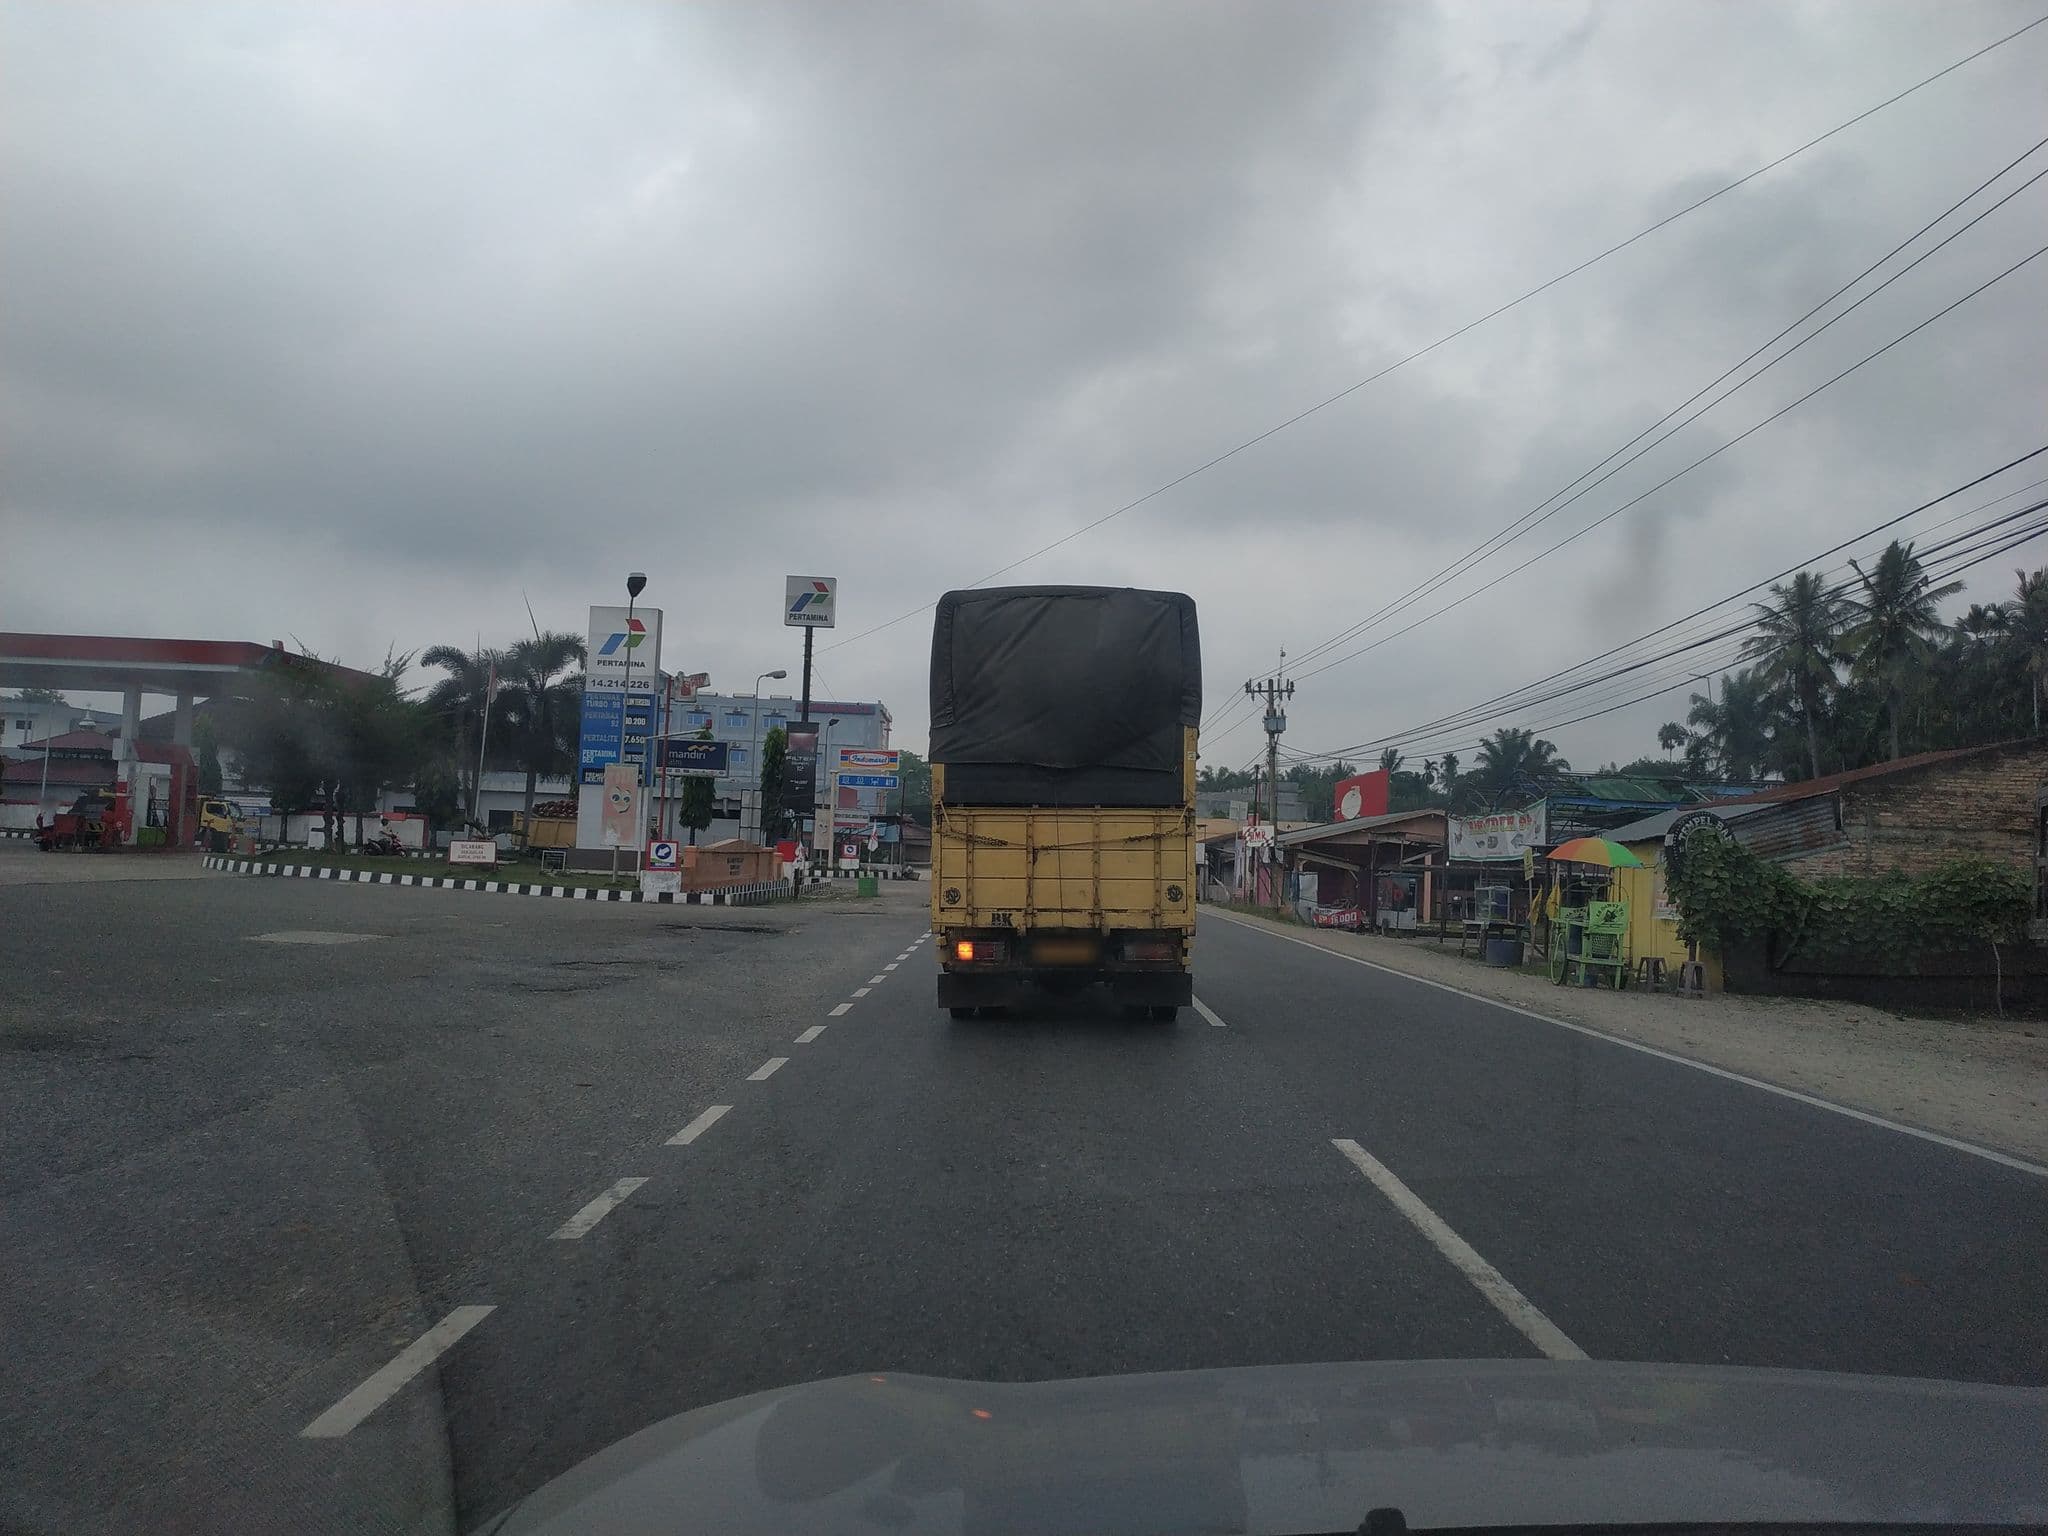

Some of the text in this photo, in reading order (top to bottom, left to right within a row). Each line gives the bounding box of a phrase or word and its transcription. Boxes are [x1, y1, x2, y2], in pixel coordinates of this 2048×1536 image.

[789, 613, 829, 621] PERTAMINA
[591, 680, 650, 689] 14.214226
[583, 734, 619, 743] PERTALITE
[624, 735, 645, 744] 7.650
[669, 750, 706, 760] mandiri
[851, 754, 888, 763] Indomaret
[1678, 816, 1713, 841] TEMPEL
